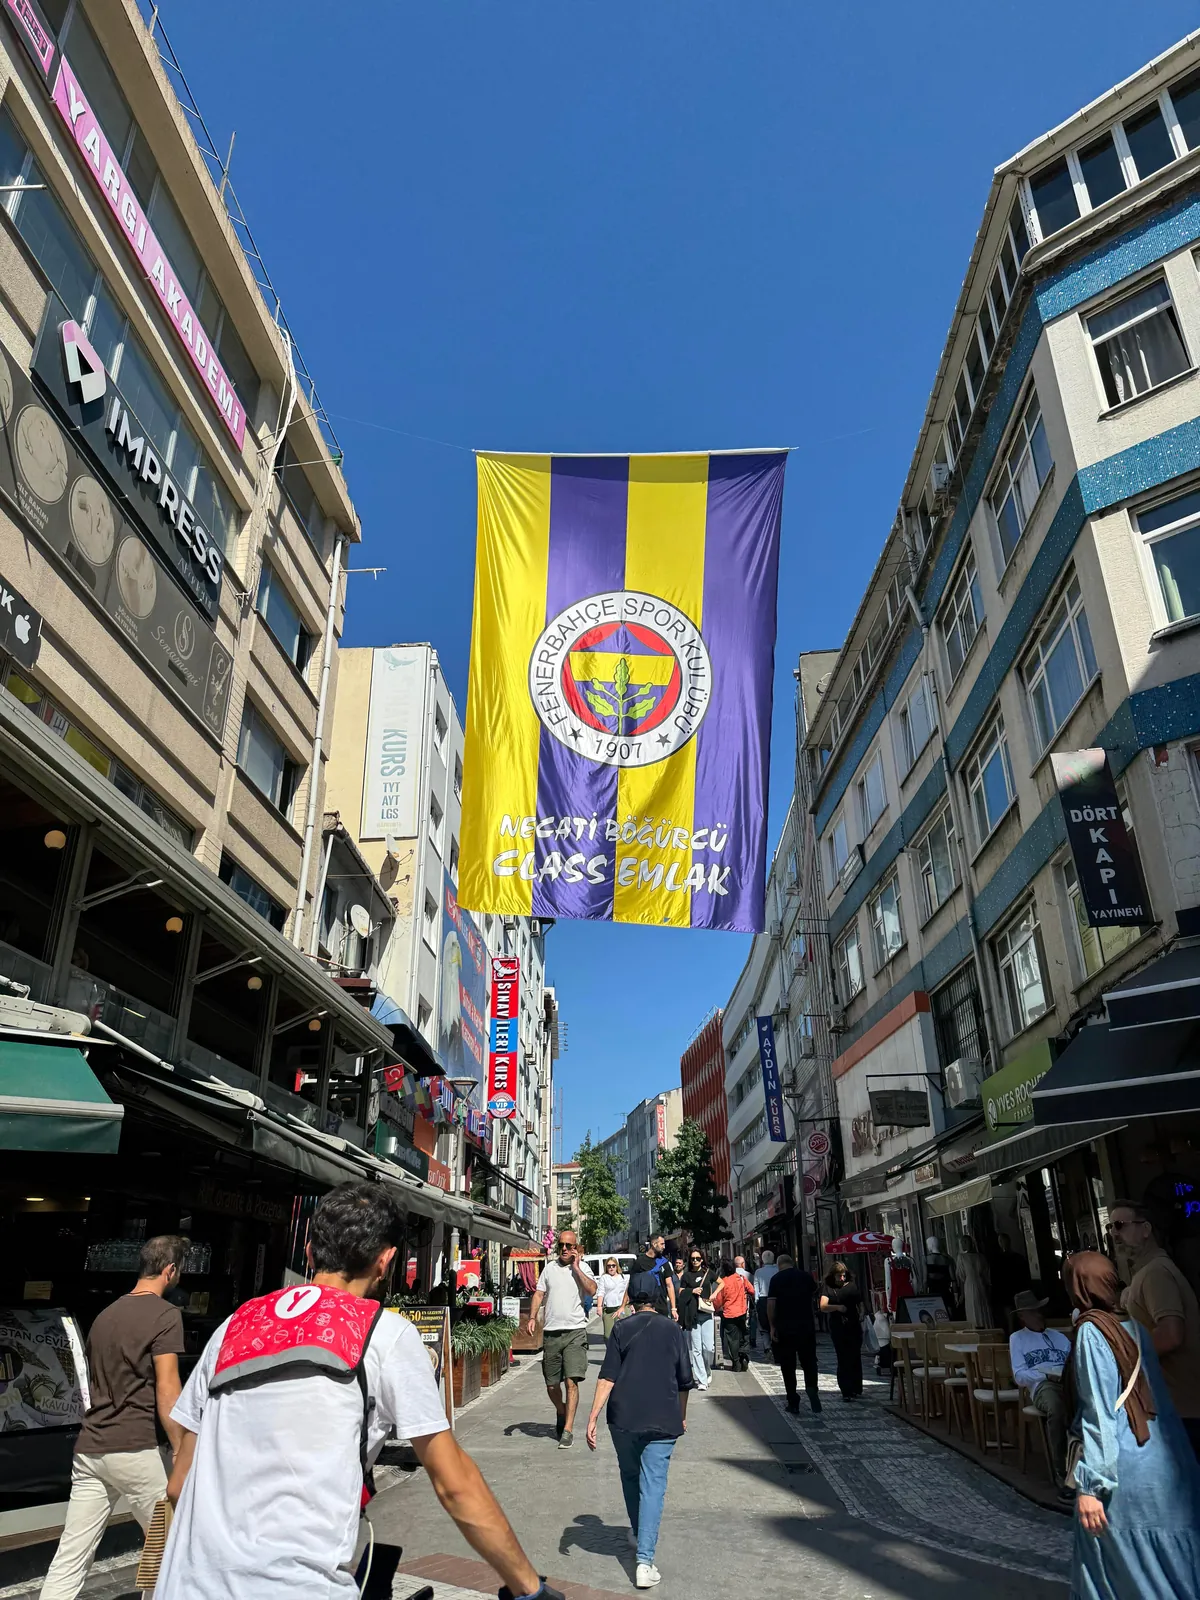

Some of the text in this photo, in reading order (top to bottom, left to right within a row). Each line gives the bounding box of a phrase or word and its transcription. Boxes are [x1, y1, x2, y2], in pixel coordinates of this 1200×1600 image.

[68, 80, 241, 431] YARGI AKADEMİ
[105, 397, 223, 584] IMPRESS
[536, 597, 708, 736] FENERBAHÇE SPOR KULÜBÜ
[380, 728, 408, 777] KURS
[594, 738, 643, 760] 1907
[382, 795, 400, 806] AYT
[383, 782, 401, 793] TYT
[381, 808, 399, 820] LGS
[1070, 805, 1118, 823] DÖRT
[499, 811, 728, 853] NECATİ BÖĞÜRCÜ
[492, 849, 731, 896] CLASS EMLAK
[1089, 828, 1118, 905] KAPI
[1092, 905, 1143, 919] YAYINEVİ
[496, 982, 512, 1018] SINAV
[495, 1021, 511, 1054] İLERİ
[494, 1056, 510, 1089] KURS
[763, 1038, 781, 1134] AYDIN KURS
[996, 1091, 1016, 1115] YVES
[286, 1289, 312, 1312] Y
[35, 1334, 75, 1350] CEVİZİ
[42, 1398, 77, 1414] KAVUN
